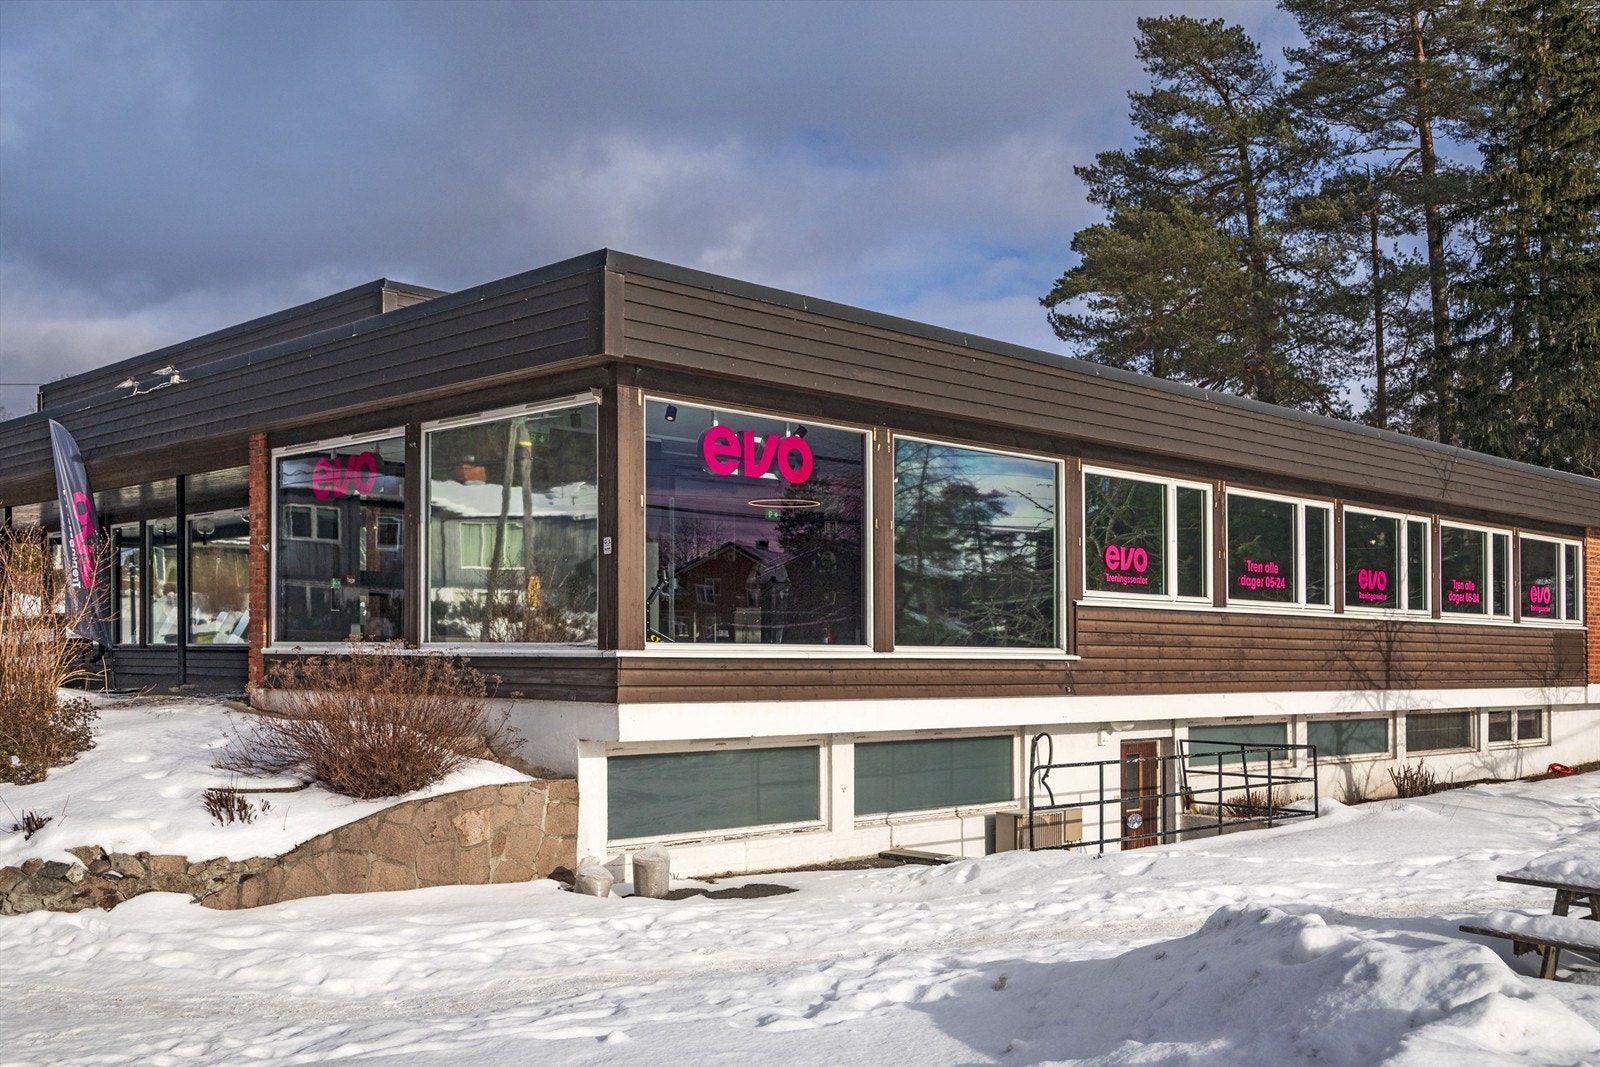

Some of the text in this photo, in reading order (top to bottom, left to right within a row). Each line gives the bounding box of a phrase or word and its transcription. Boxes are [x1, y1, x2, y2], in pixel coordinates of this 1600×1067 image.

[702, 425, 814, 485] evo
[312, 452, 376, 501] evo
[1105, 545, 1148, 573] evo
[1246, 559, 1279, 574] Tren alle
[1105, 573, 1148, 585] Treningssenter
[1240, 575, 1286, 590] dager 05-24
[1358, 569, 1387, 591] evo
[1452, 579, 1464, 590] Tren
[1530, 585, 1551, 604] evo
